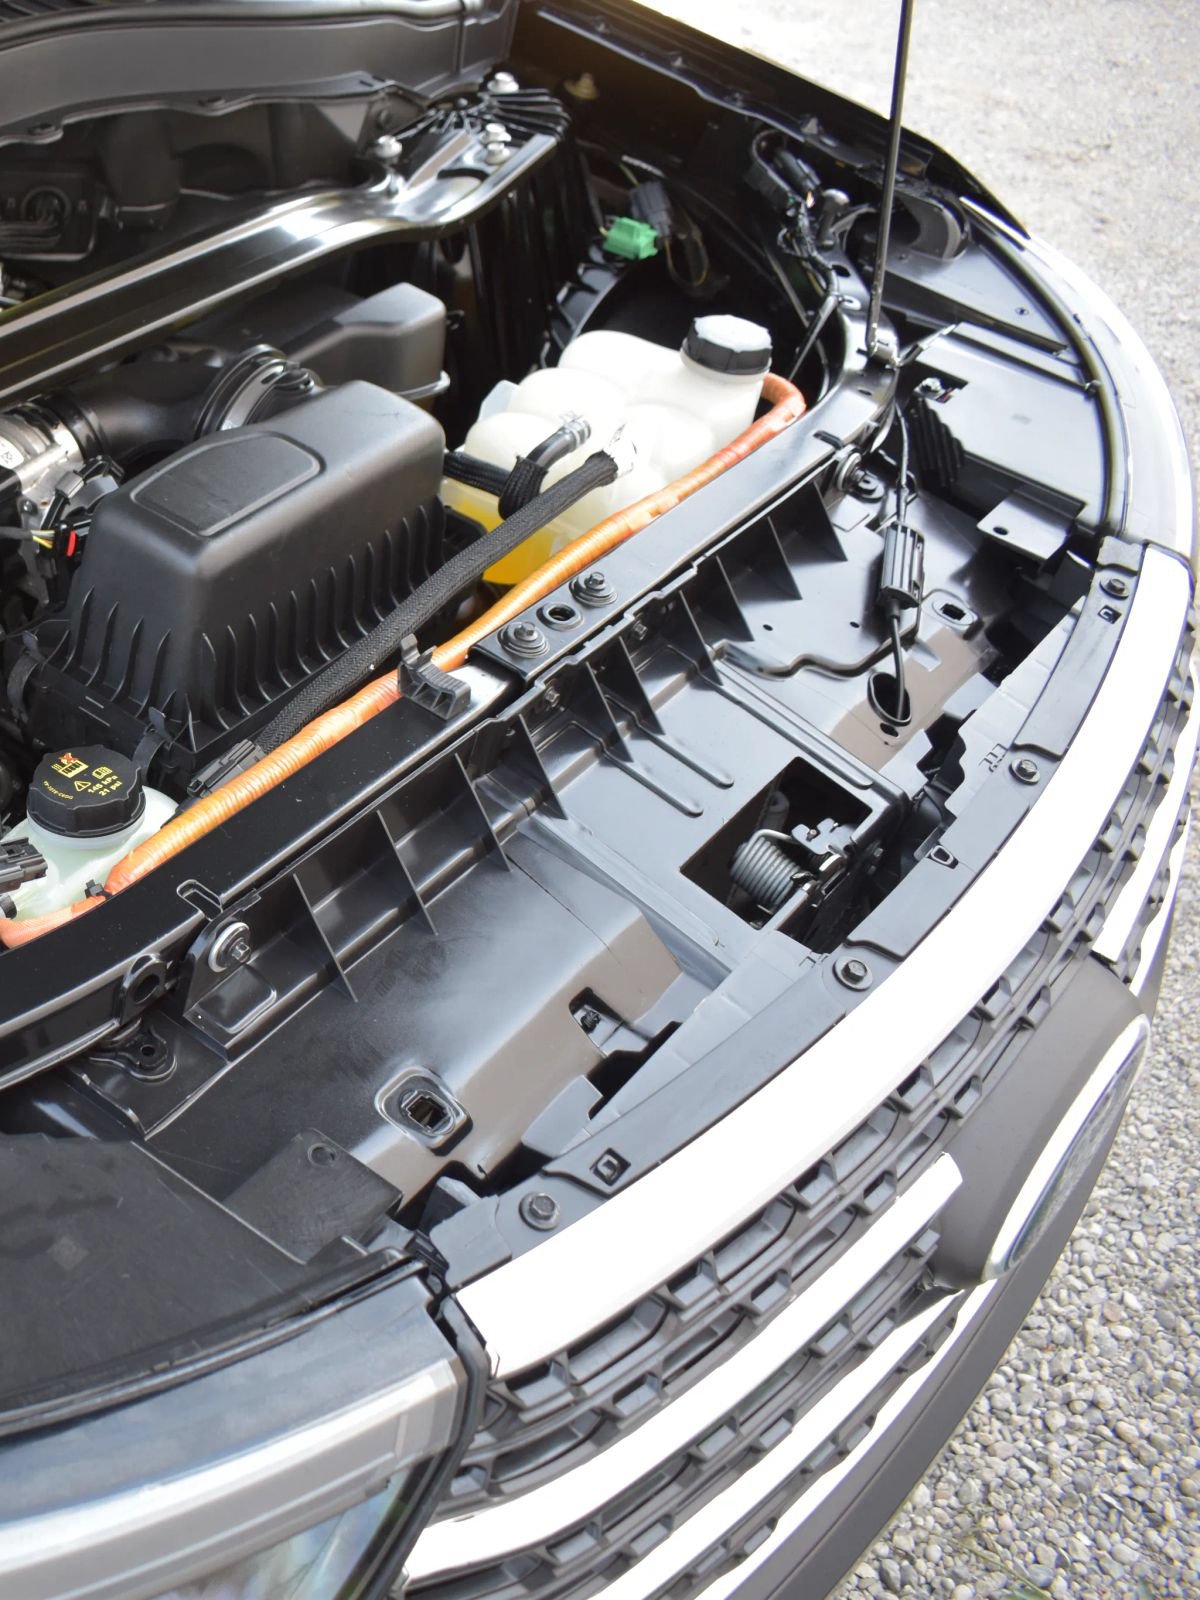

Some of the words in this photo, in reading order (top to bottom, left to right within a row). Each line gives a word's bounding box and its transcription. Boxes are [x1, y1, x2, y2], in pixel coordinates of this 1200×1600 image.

[101, 775, 118, 785] kPa
[98, 788, 110, 796] 21
[110, 780, 123, 790] psi
